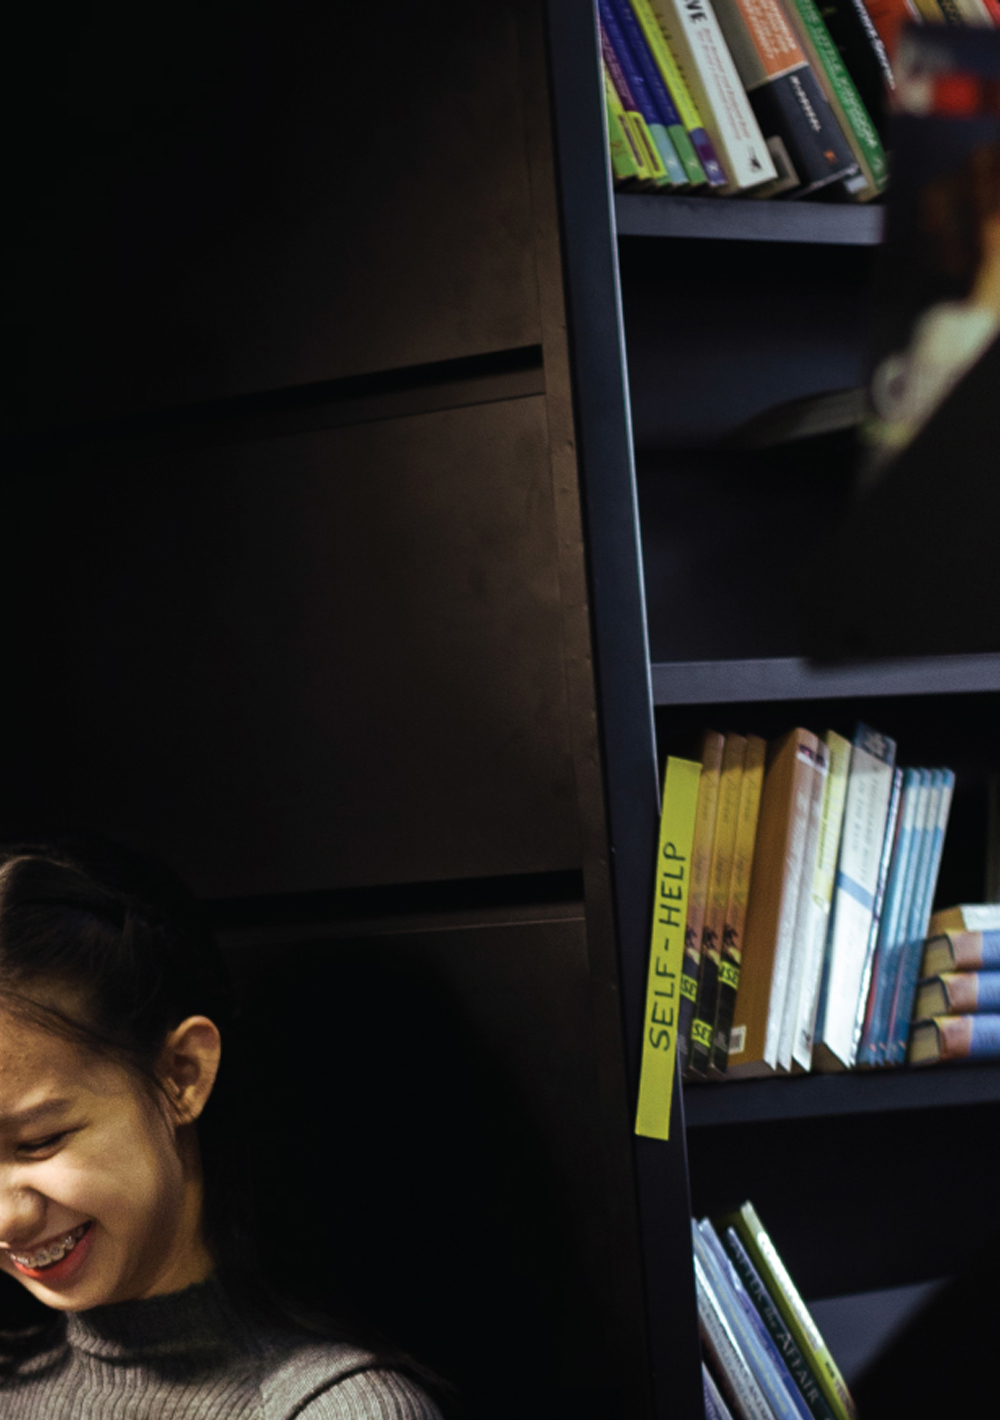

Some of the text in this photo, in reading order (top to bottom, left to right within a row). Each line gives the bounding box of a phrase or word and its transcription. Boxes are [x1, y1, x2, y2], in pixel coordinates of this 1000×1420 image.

[729, 1238, 764, 1303] AFTER
[764, 1304, 779, 1329] the
[777, 1331, 821, 1403] AFFAIR
